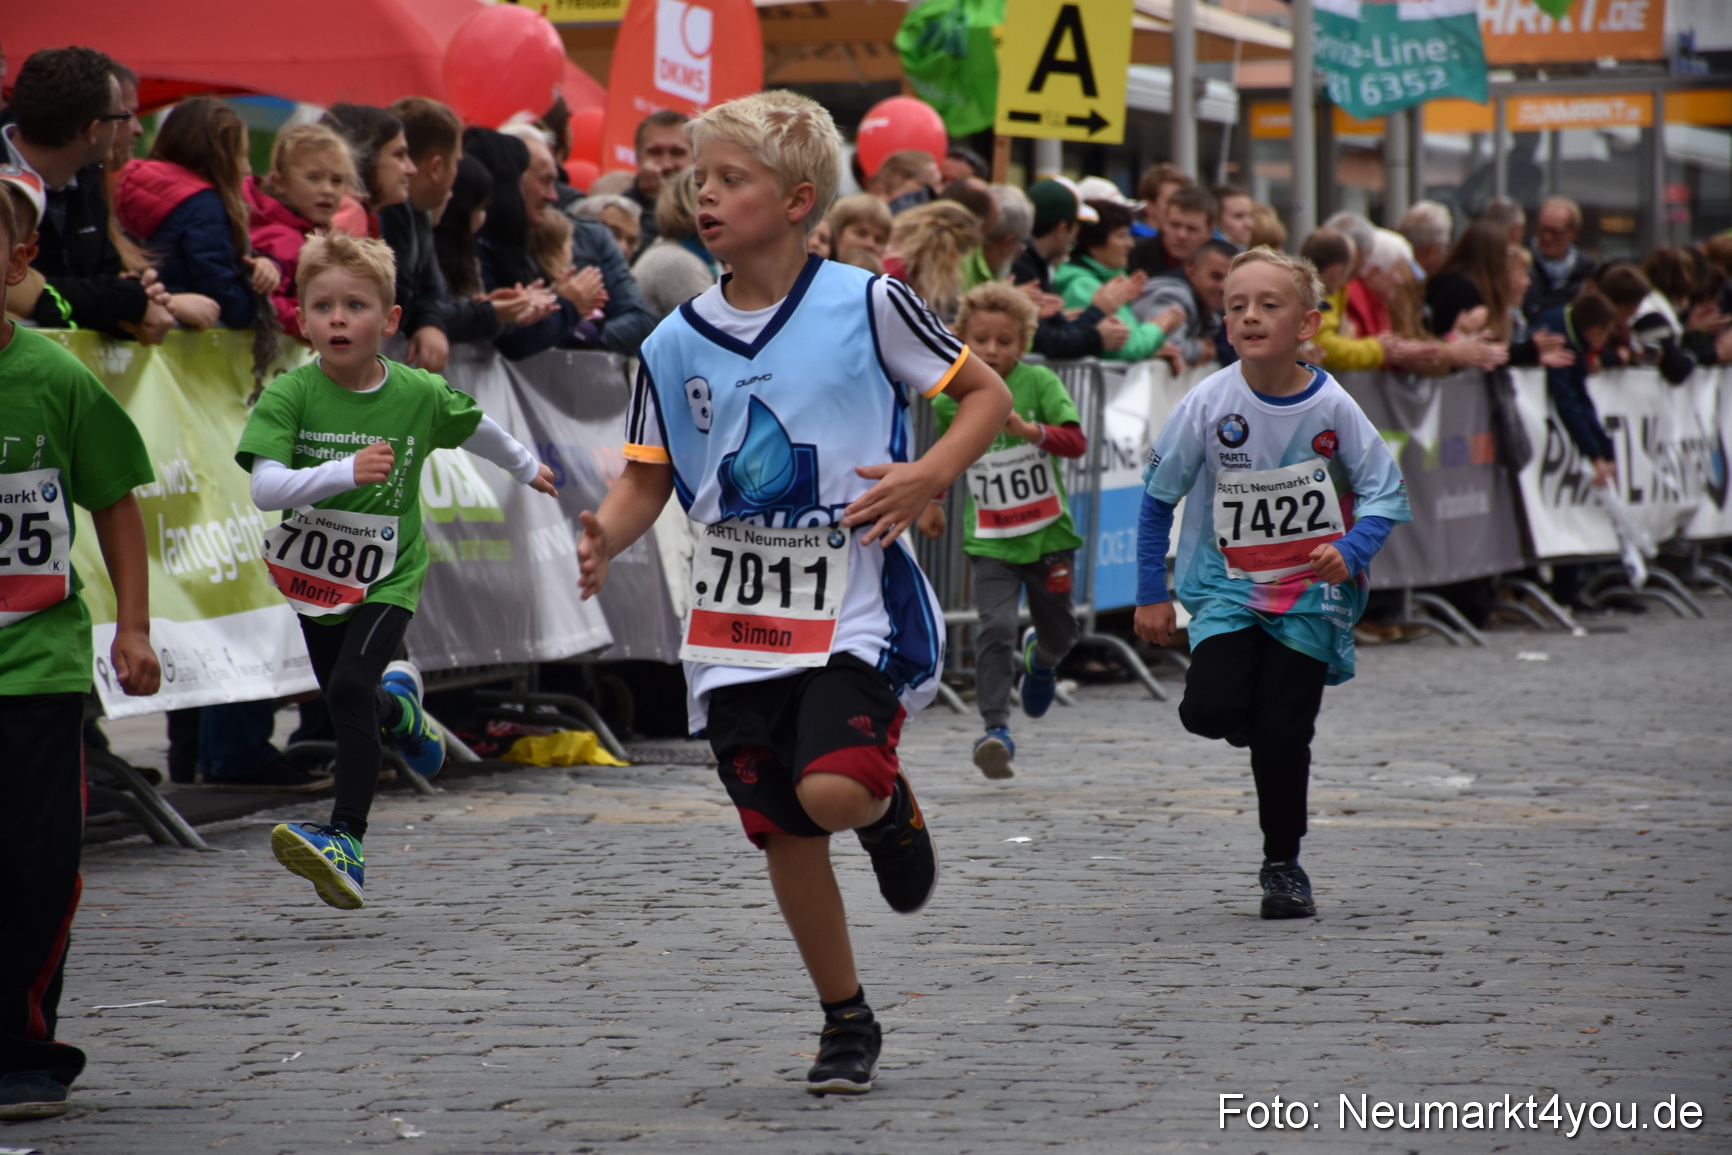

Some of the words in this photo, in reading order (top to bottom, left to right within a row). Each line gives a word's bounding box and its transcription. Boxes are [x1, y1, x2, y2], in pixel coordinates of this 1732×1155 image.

[1027, 4, 1098, 99] A
[660, 57, 705, 93] DKMS
[1360, 65, 1449, 106] 6352
[1220, 452, 1252, 463] PARTL
[1221, 460, 1252, 469] Neumarkt
[975, 463, 1048, 505] 7160
[1217, 482, 1249, 495] PARTL
[1251, 475, 1311, 493] Neumarkt
[316, 518, 377, 539] Neumarkt
[1223, 490, 1330, 541] 7422
[276, 521, 384, 585] 7080
[745, 530, 820, 548] Neumarkt
[53, 561, 60, 573] K
[711, 547, 828, 611] 7011
[290, 577, 344, 605] Moritz
[731, 620, 792, 647] Simon
